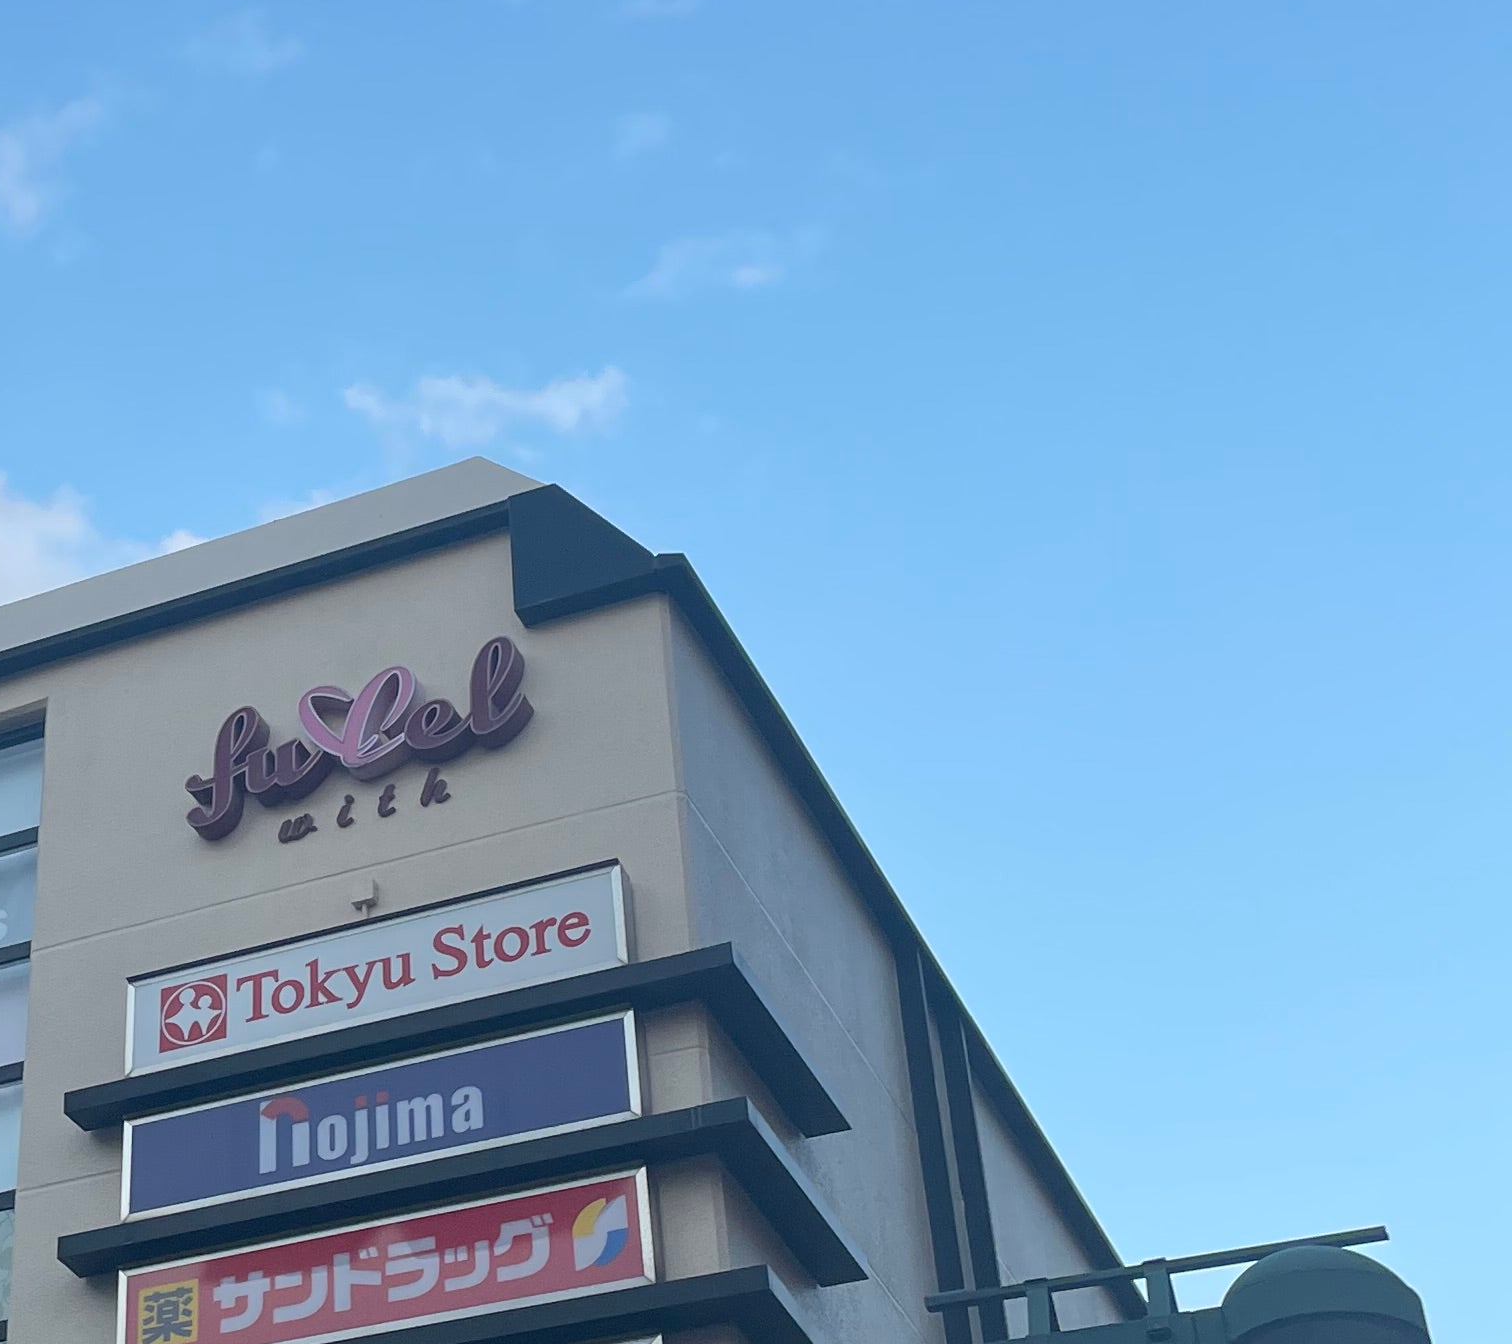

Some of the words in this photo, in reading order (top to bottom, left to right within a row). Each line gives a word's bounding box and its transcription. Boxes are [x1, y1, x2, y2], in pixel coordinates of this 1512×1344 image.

[278, 768, 451, 843] with
[236, 958, 415, 1023] Tokyu
[431, 910, 592, 980] Store
[213, 1212, 554, 1334] サンドラッグ
